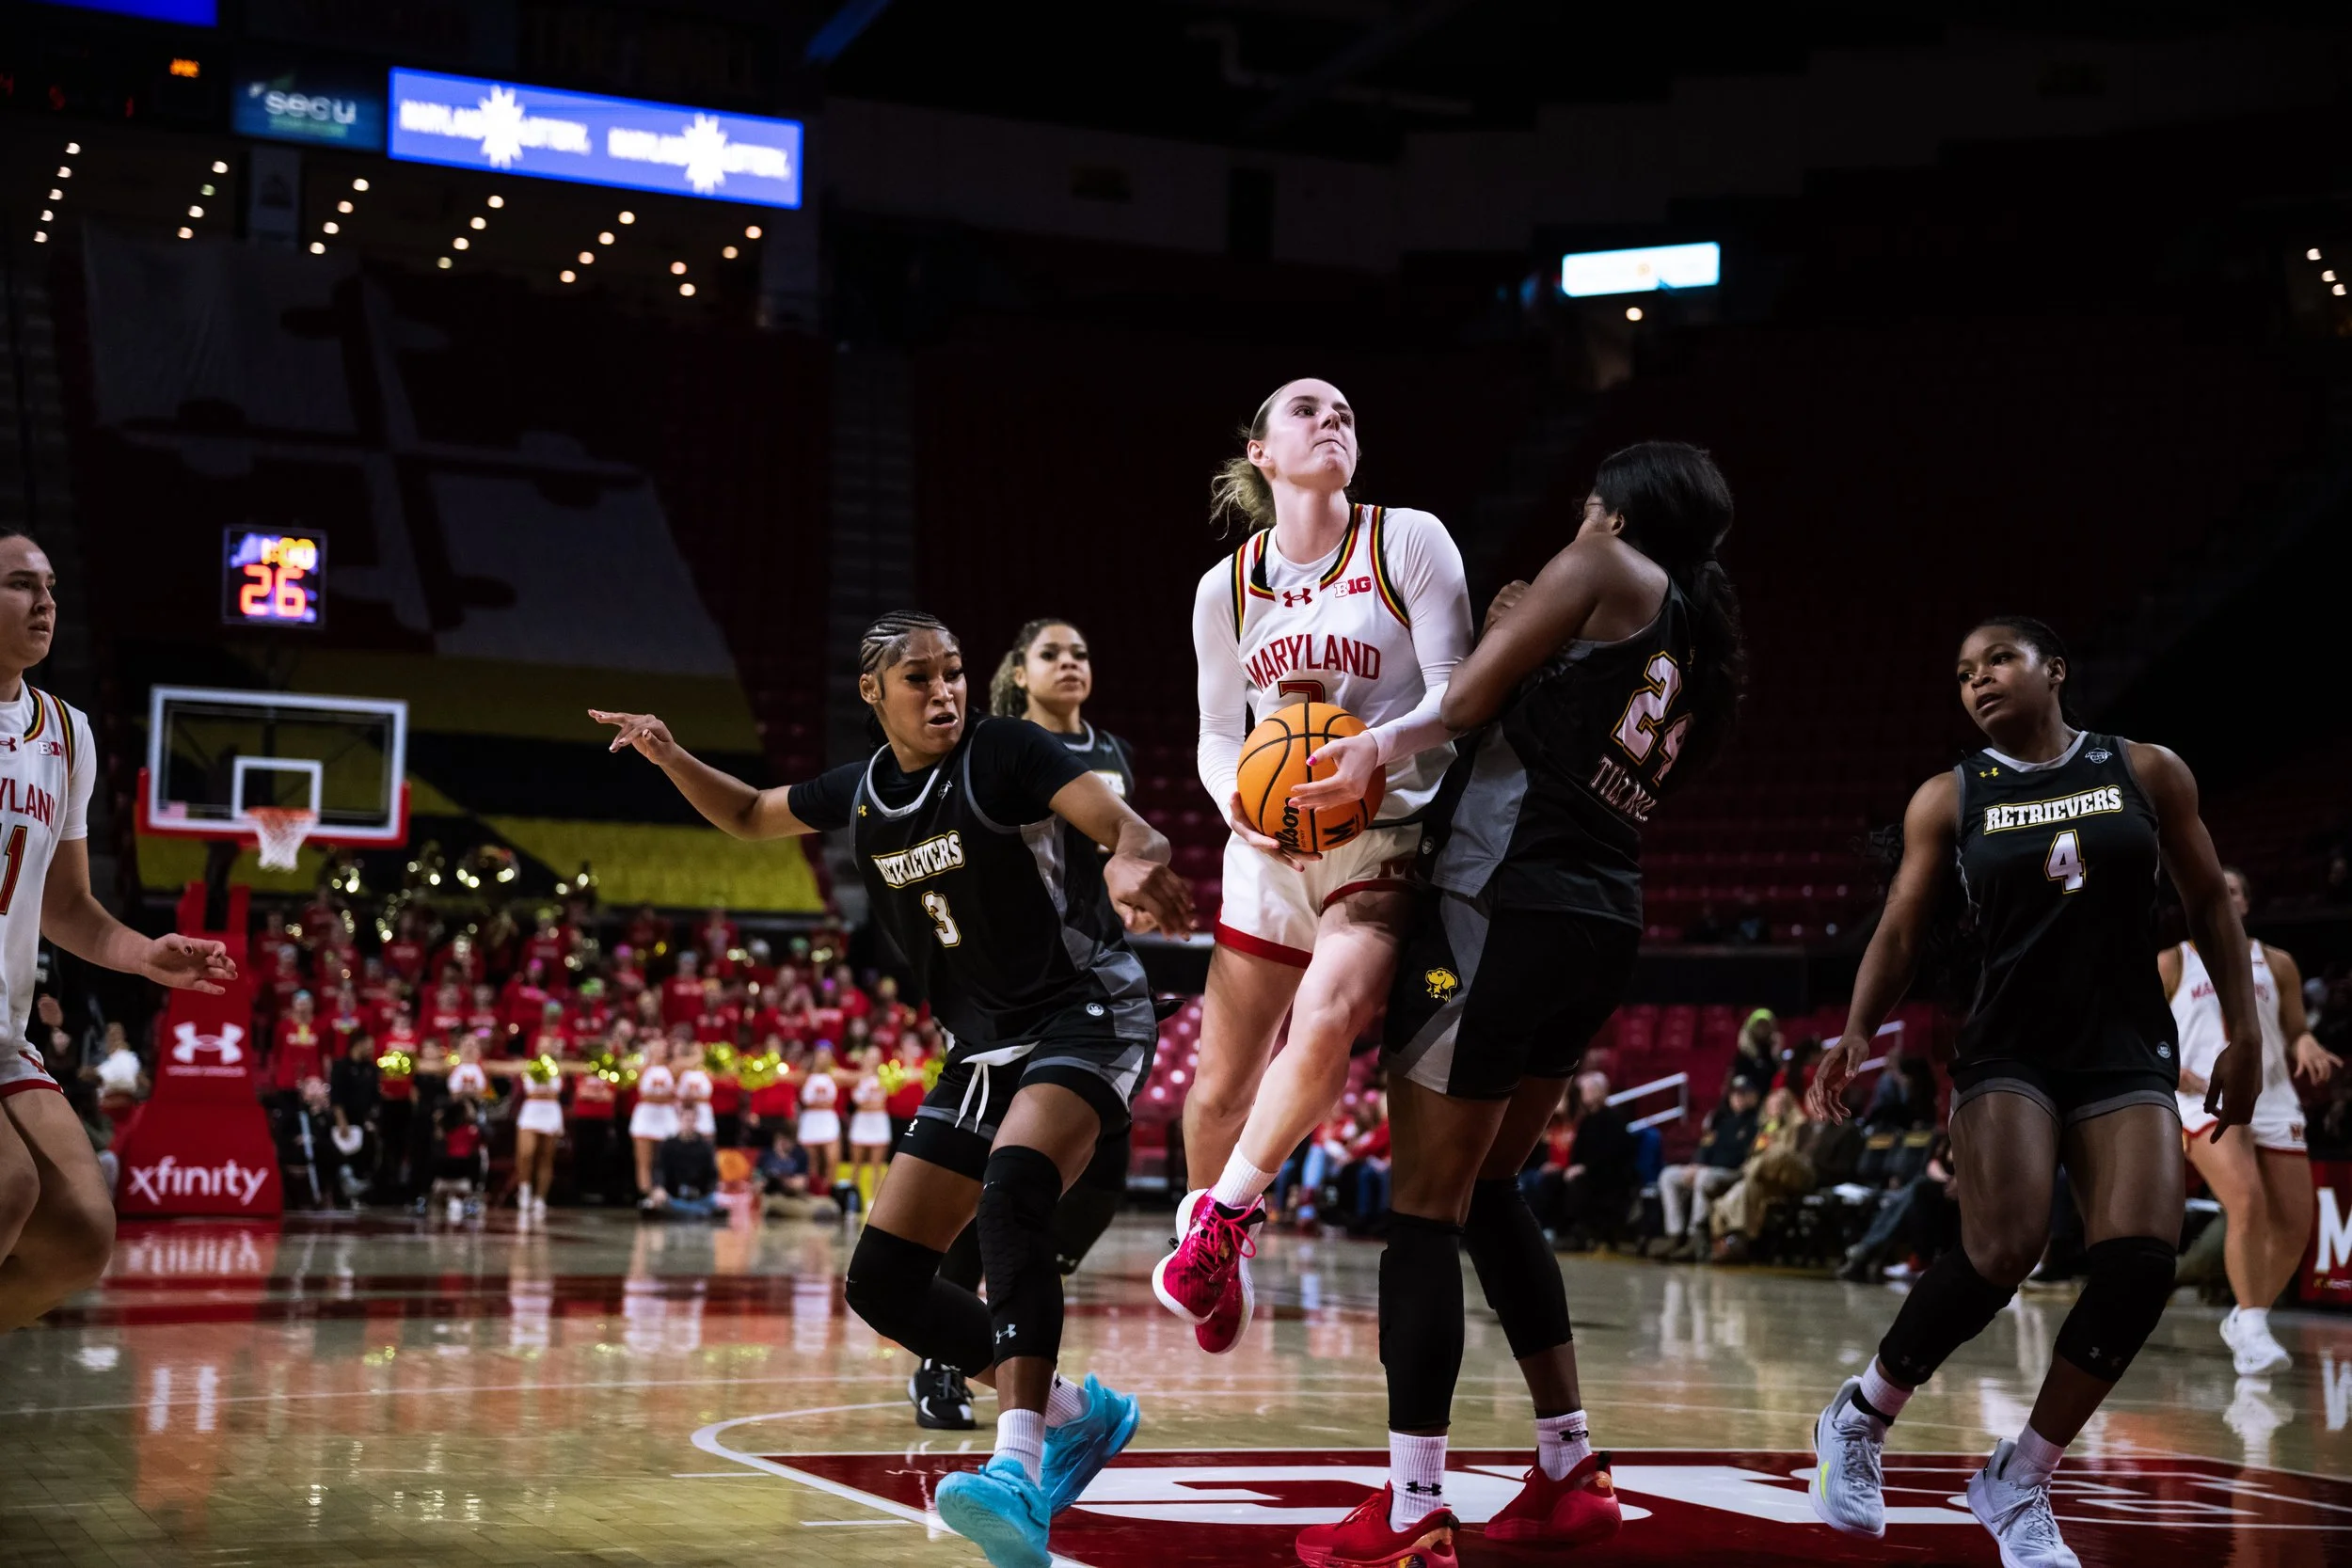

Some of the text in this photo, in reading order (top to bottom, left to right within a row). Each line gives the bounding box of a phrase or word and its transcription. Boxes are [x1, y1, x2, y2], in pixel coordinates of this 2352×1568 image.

[240, 563, 308, 617] 26
[1333, 576, 1372, 598] B1G
[1246, 633, 1380, 694] MARYLAND
[1984, 784, 2123, 835] RETRIEVERS
[2042, 829, 2087, 895] 4
[921, 890, 962, 948] 3
[127, 1155, 270, 1206] xfinity
